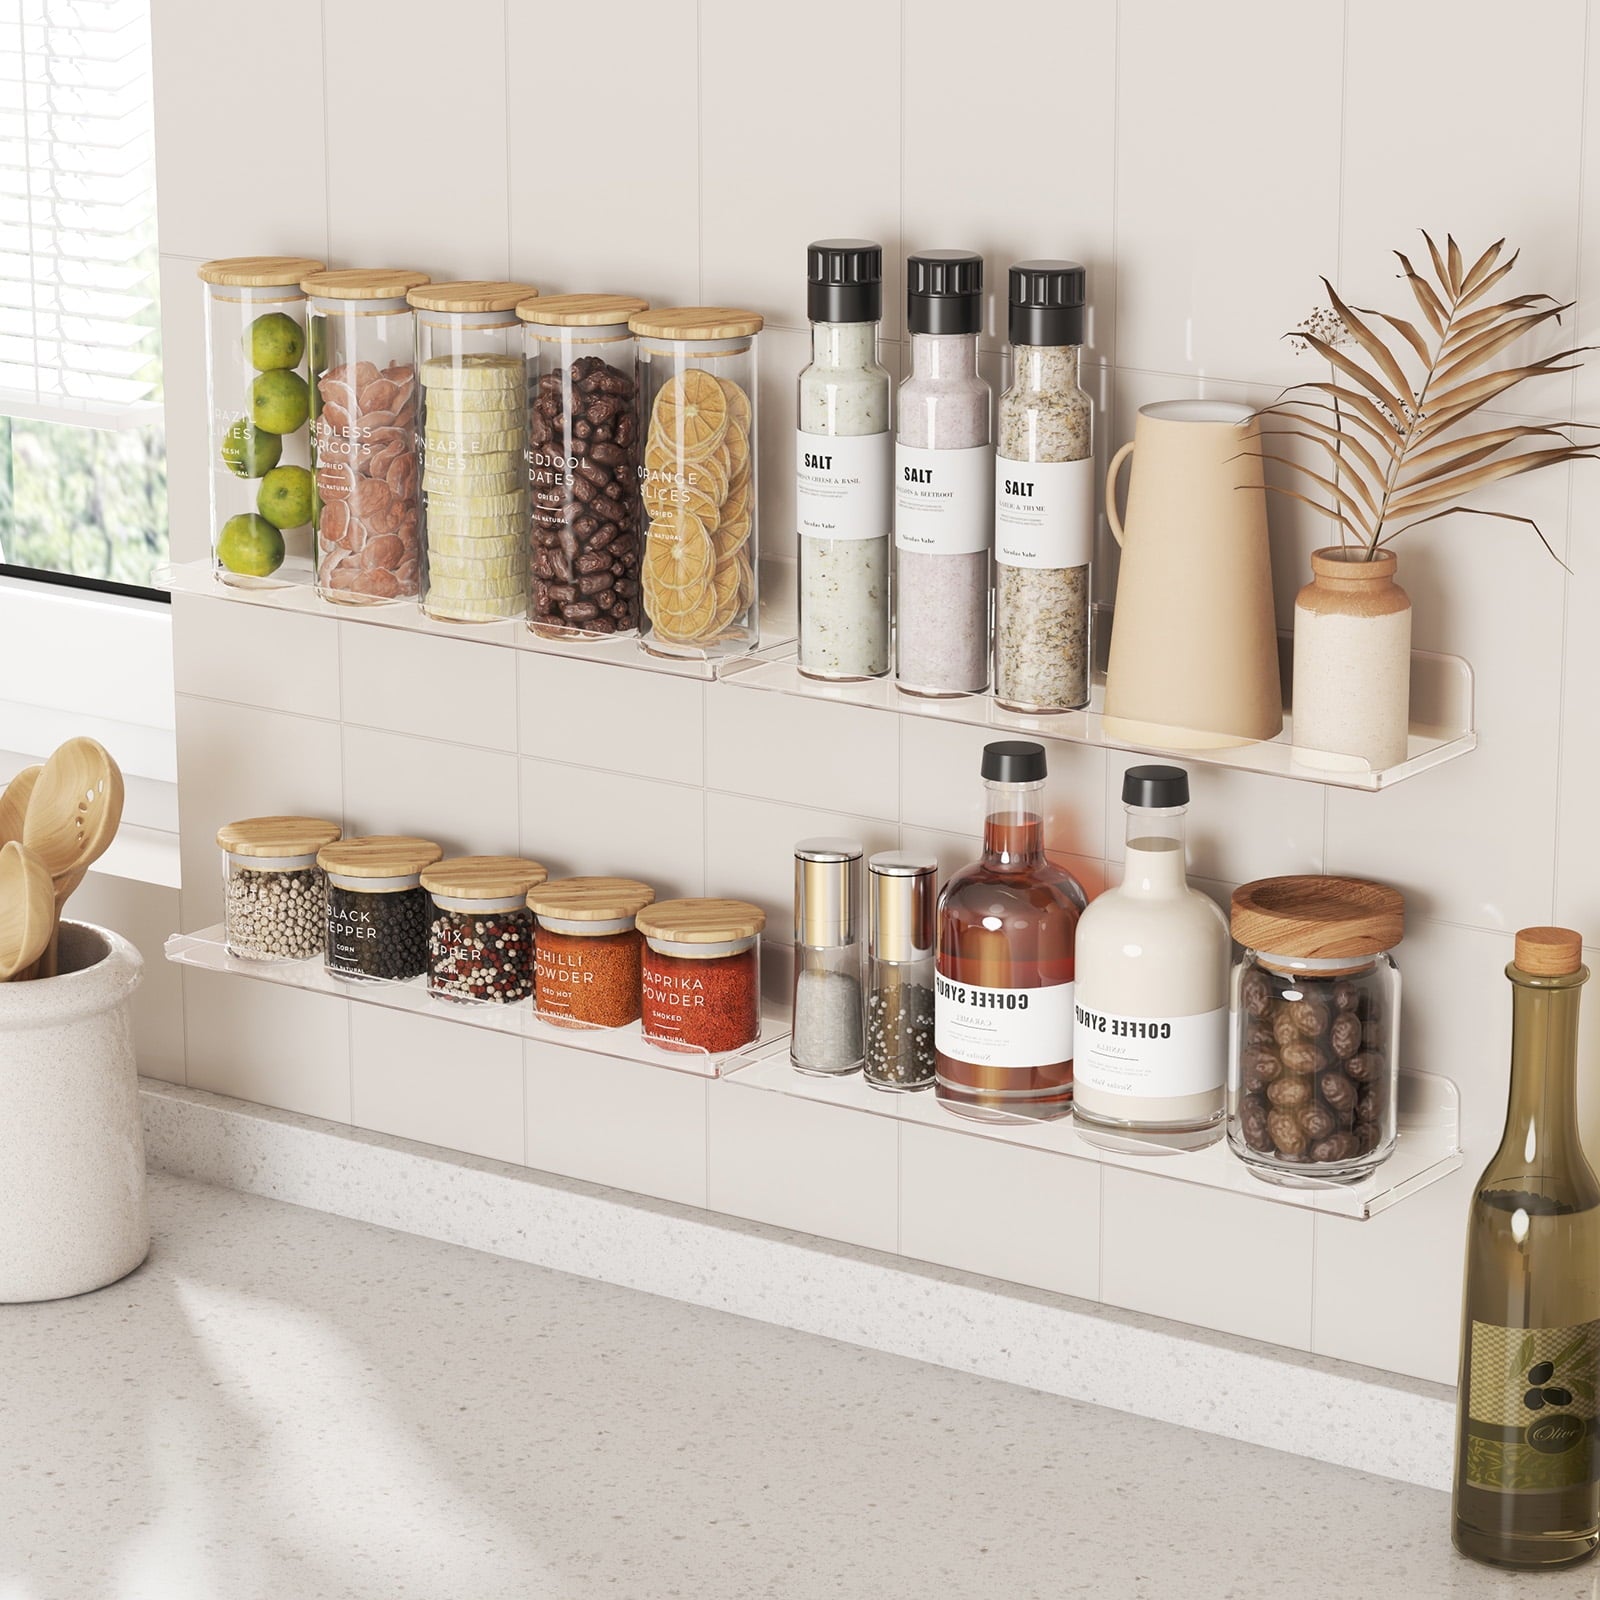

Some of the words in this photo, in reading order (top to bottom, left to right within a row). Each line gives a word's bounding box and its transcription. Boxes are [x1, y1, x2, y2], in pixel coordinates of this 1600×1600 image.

[523, 448, 591, 469] MEDJOOL
[804, 452, 833, 470] SALT
[528, 468, 574, 486] DATES
[637, 465, 697, 485] ORANGE
[904, 466, 933, 484] SALT
[640, 483, 691, 503] SLICES
[1005, 479, 1034, 497] SALT
[537, 493, 560, 502] DRIED
[650, 509, 673, 518] DRIED
[1023, 504, 1046, 512] THYME
[542, 516, 569, 524] NATURAL
[327, 903, 370, 923] BLACK
[437, 928, 462, 943] MIX
[336, 944, 355, 952] CORN
[536, 947, 582, 967] CHILLI
[643, 967, 704, 990] PAPRIKA
[542, 986, 555, 995] RED
[643, 983, 705, 1006] POWDER
[652, 1010, 682, 1021] SMOKED
